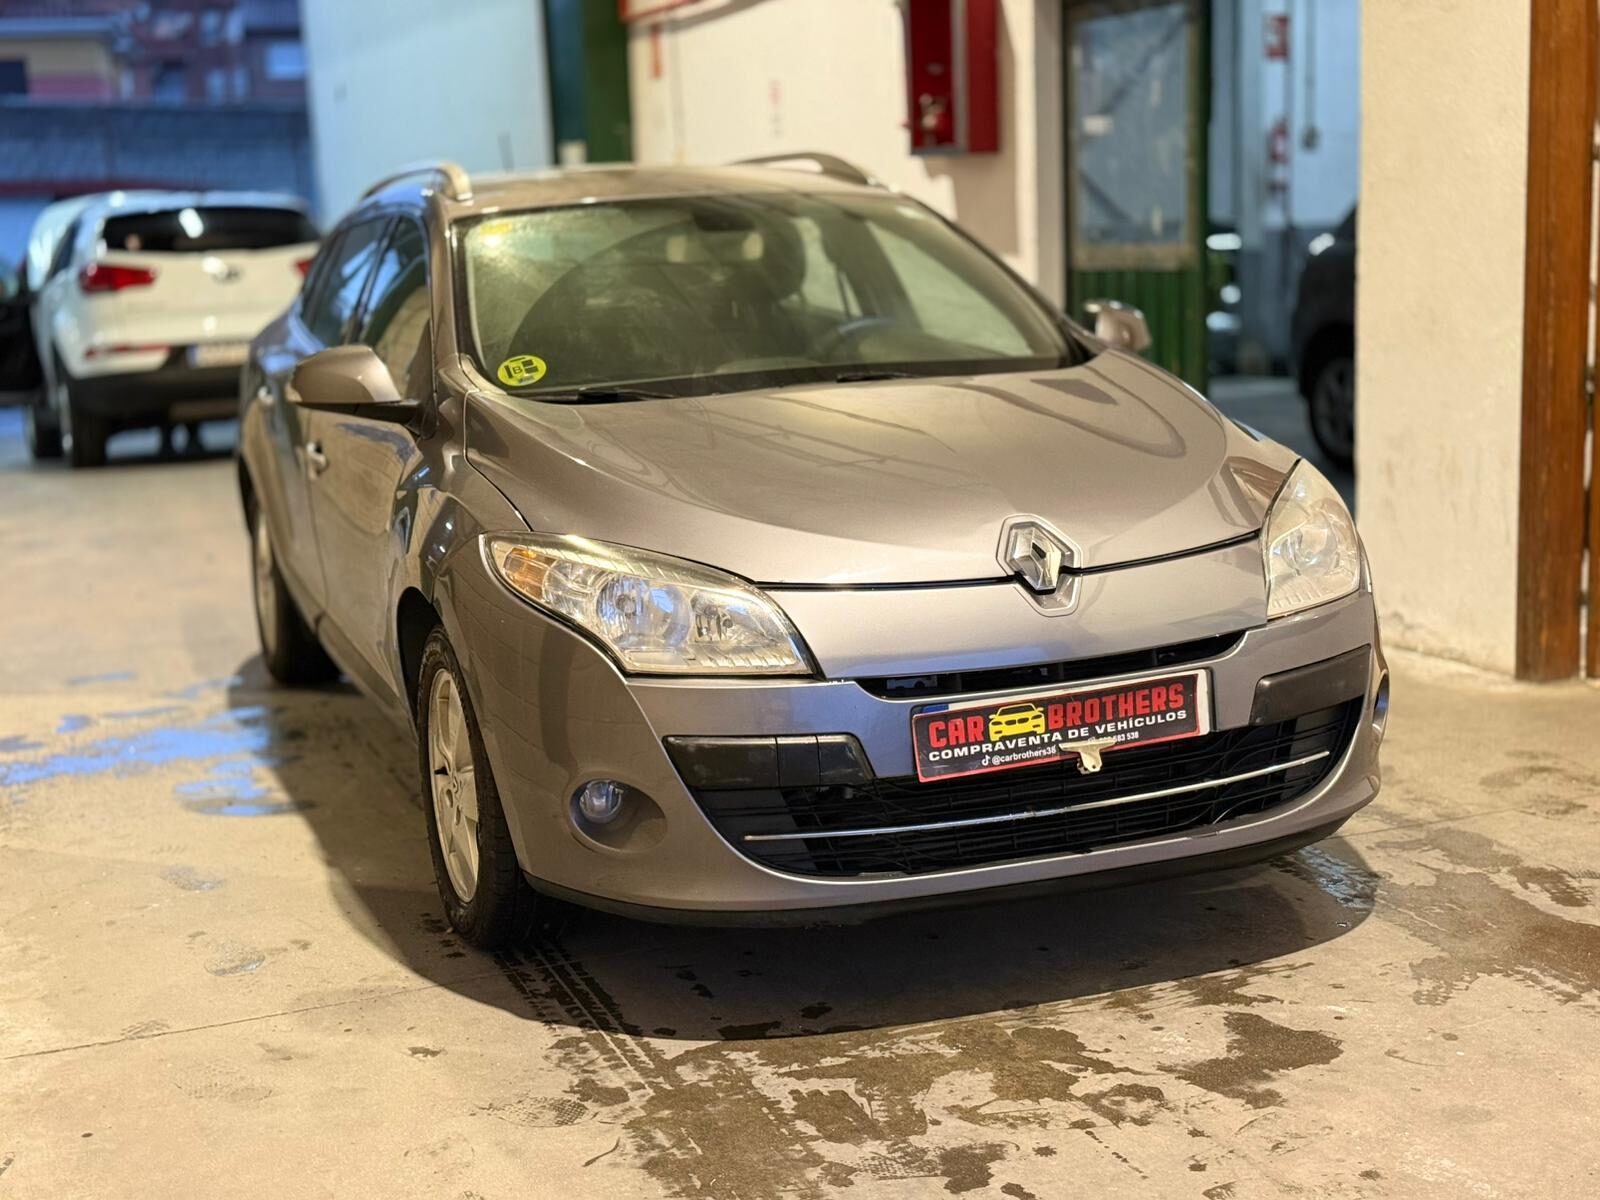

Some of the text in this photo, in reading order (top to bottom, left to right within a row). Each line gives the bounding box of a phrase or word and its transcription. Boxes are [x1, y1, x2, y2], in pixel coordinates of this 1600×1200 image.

[928, 683, 1184, 748] CAR BROTHERS
[928, 710, 1187, 762] COMPRAVENTA DE VEHÍCULOS
